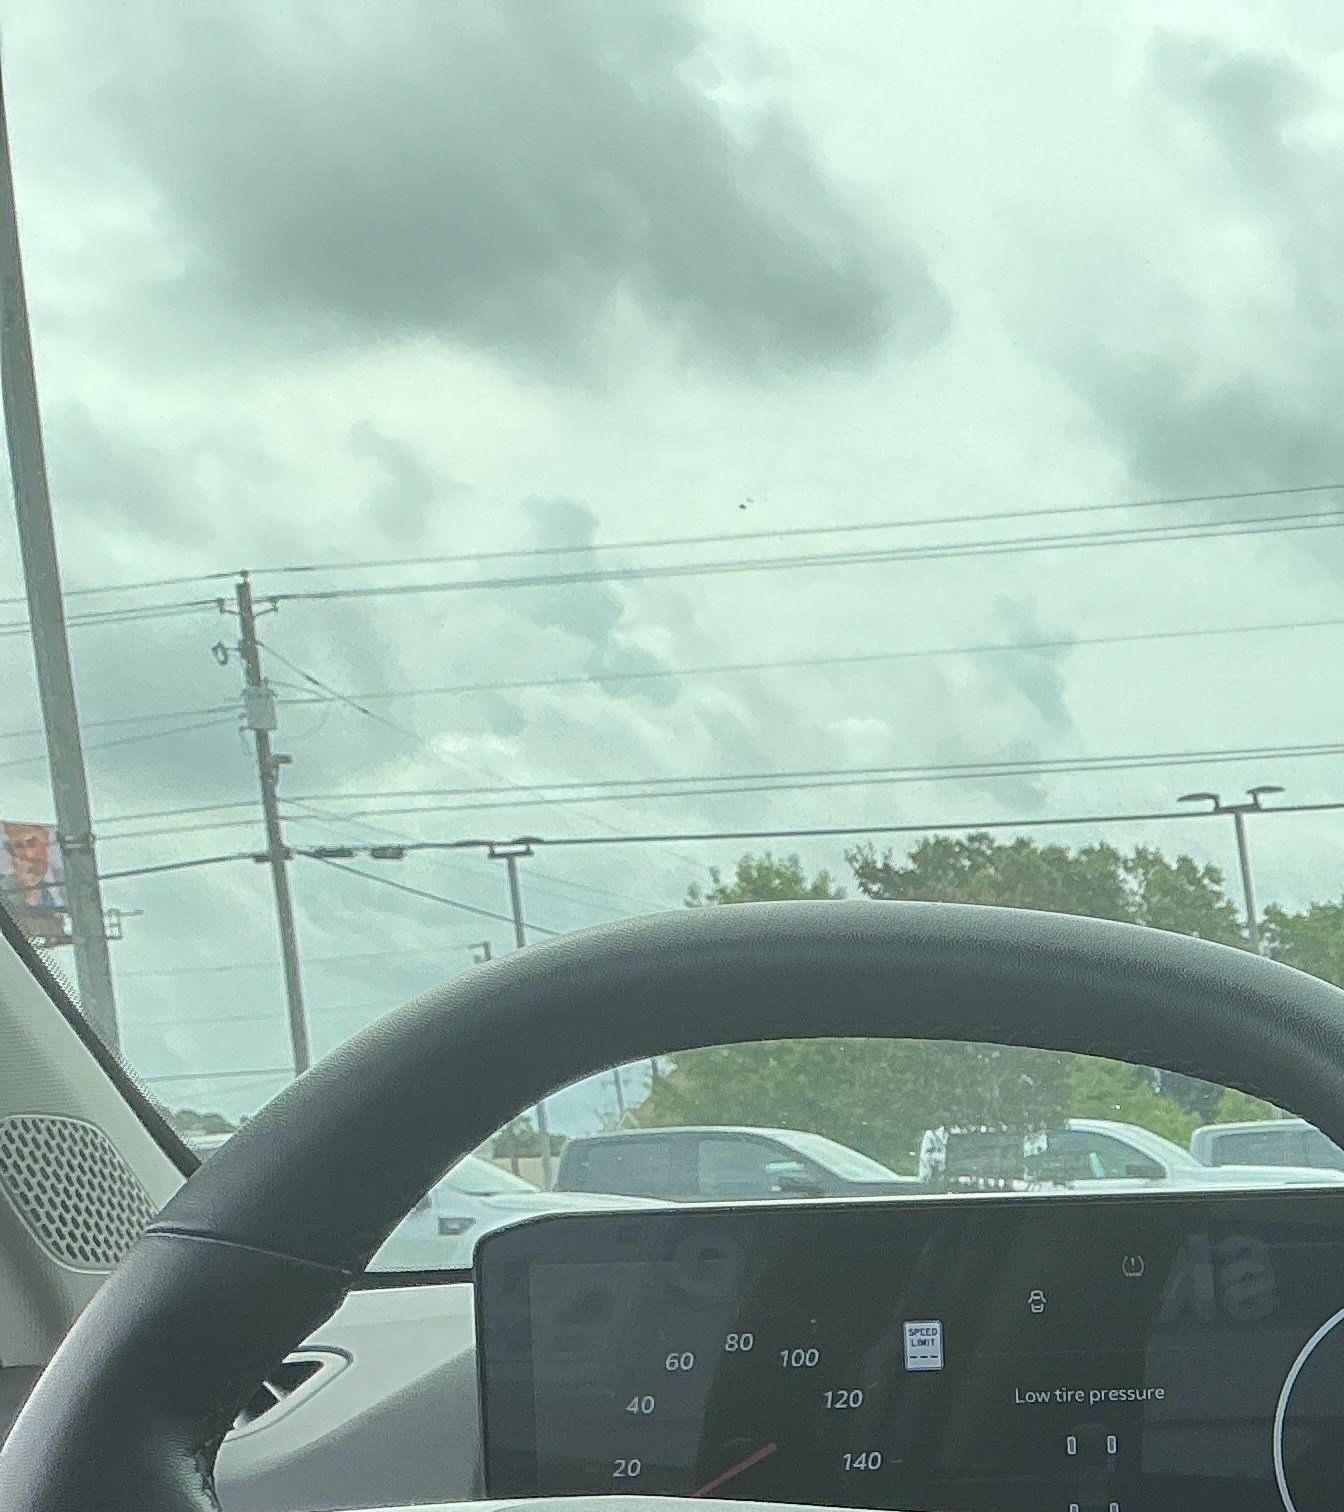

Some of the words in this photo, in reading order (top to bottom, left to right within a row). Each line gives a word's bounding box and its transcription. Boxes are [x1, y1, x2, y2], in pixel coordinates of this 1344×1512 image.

[907, 1327, 938, 1337] SPEED
[725, 1334, 753, 1351] 80
[666, 1353, 693, 1370] 60
[781, 1349, 818, 1367] 100
[627, 1396, 654, 1413] 40
[825, 1390, 862, 1408] 120
[1016, 1389, 1050, 1403] Low
[1055, 1388, 1084, 1402] tire
[1090, 1389, 1164, 1404] pressure
[614, 1459, 640, 1476] 20
[844, 1452, 881, 1470] 140
